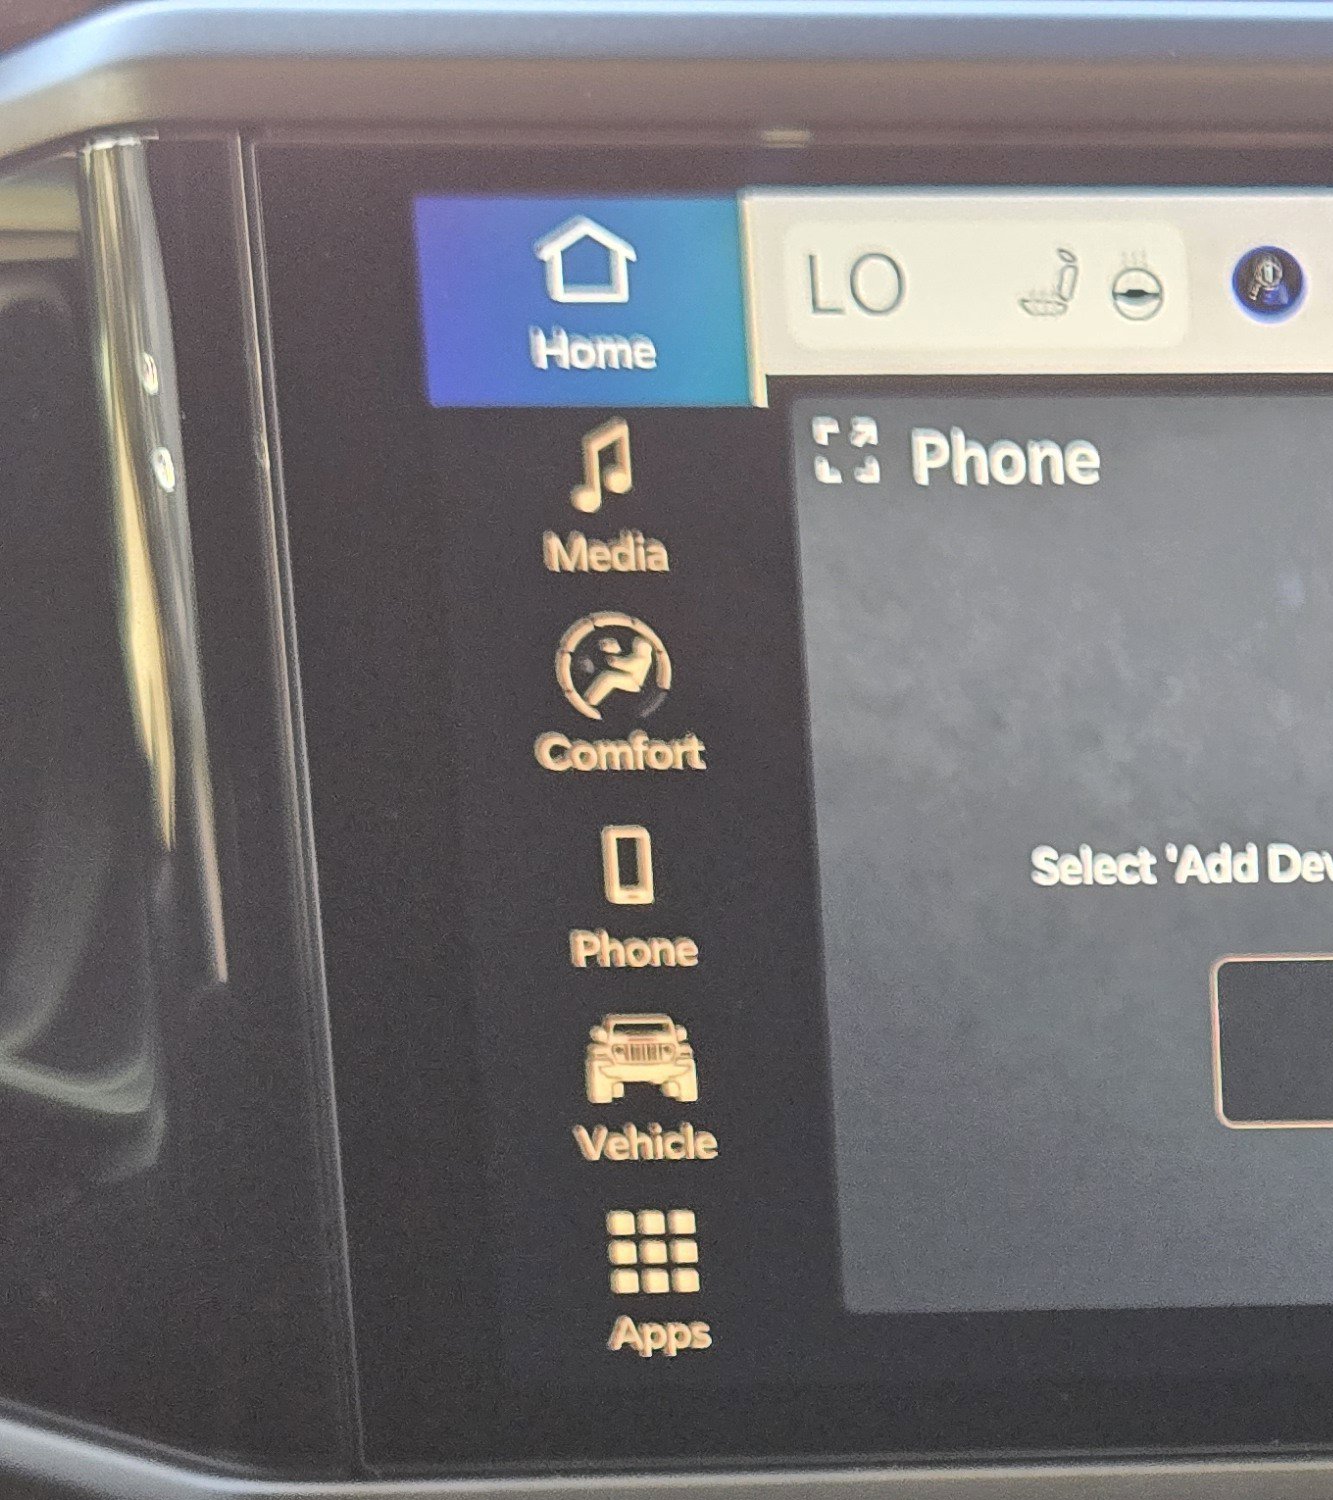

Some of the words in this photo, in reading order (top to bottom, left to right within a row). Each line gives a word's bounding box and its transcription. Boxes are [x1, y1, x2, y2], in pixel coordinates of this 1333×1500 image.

[807, 252, 907, 317] LO
[528, 326, 658, 371] Home
[909, 426, 1103, 488] Phone
[541, 530, 671, 574] Media
[533, 730, 708, 773] Comfort
[1029, 845, 1158, 887] Select
[1165, 843, 1258, 885] 'Add
[568, 928, 700, 970] Phone
[573, 1122, 719, 1162] Vehicle
[608, 1316, 712, 1358] Apps
